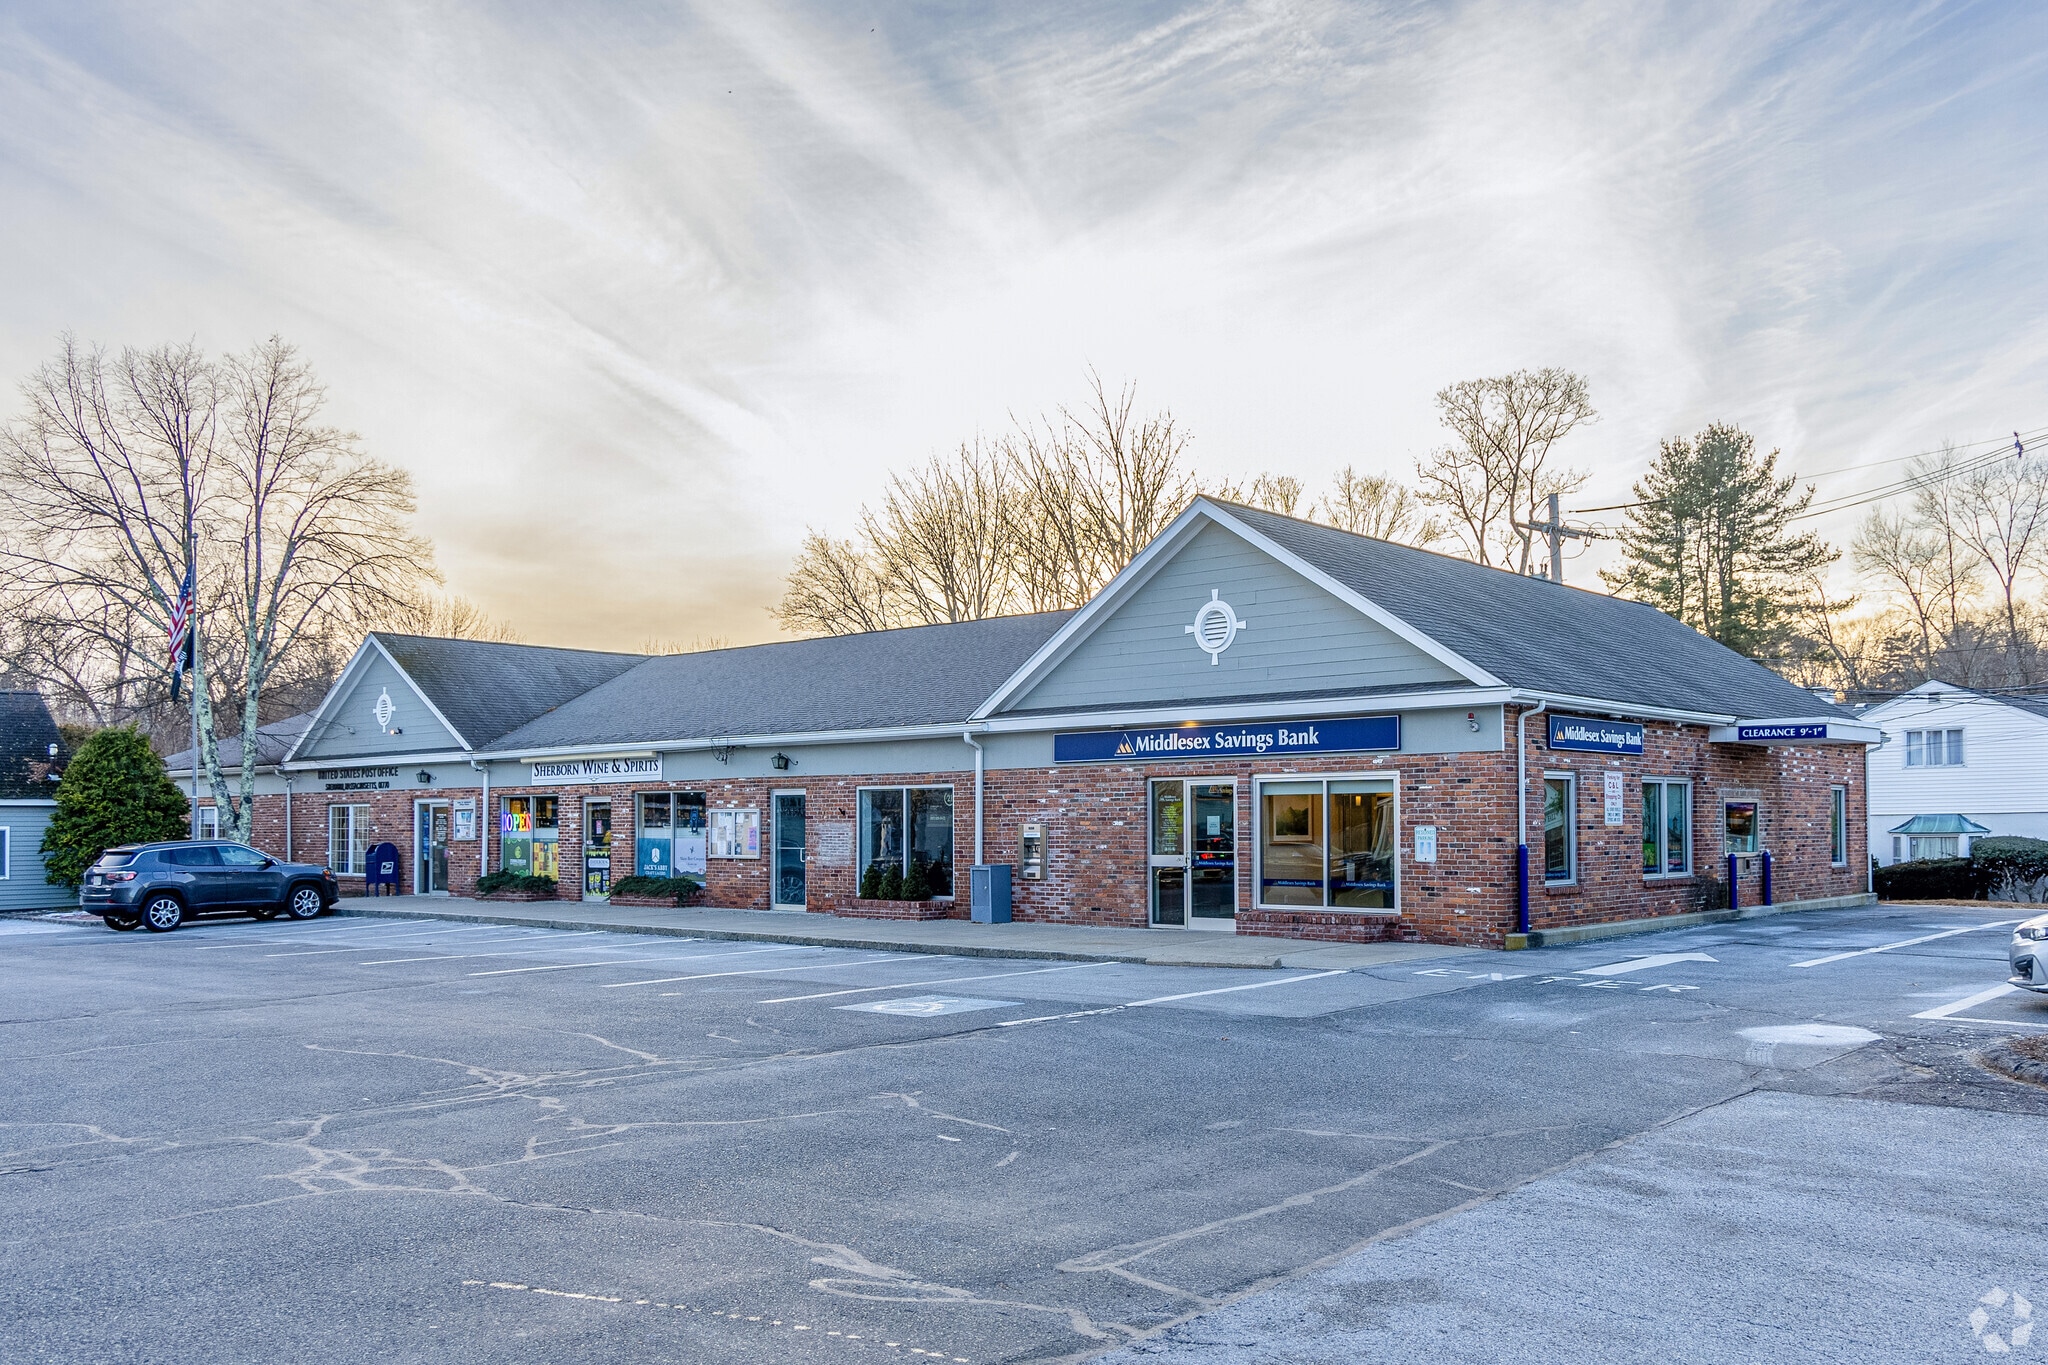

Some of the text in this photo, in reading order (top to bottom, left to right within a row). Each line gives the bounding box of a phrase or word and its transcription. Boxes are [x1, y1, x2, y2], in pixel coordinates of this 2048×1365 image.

[1136, 726, 1319, 752] Middlesex Savings Bank
[1564, 726, 1642, 748] Middlesex Savings Bank
[1742, 728, 1796, 737] CLEARANCE
[318, 766, 399, 780] UNITED STATES POST OFFICE
[534, 758, 659, 777] SHERBORN WINE & SPIRITS
[505, 812, 532, 832] OPEN
